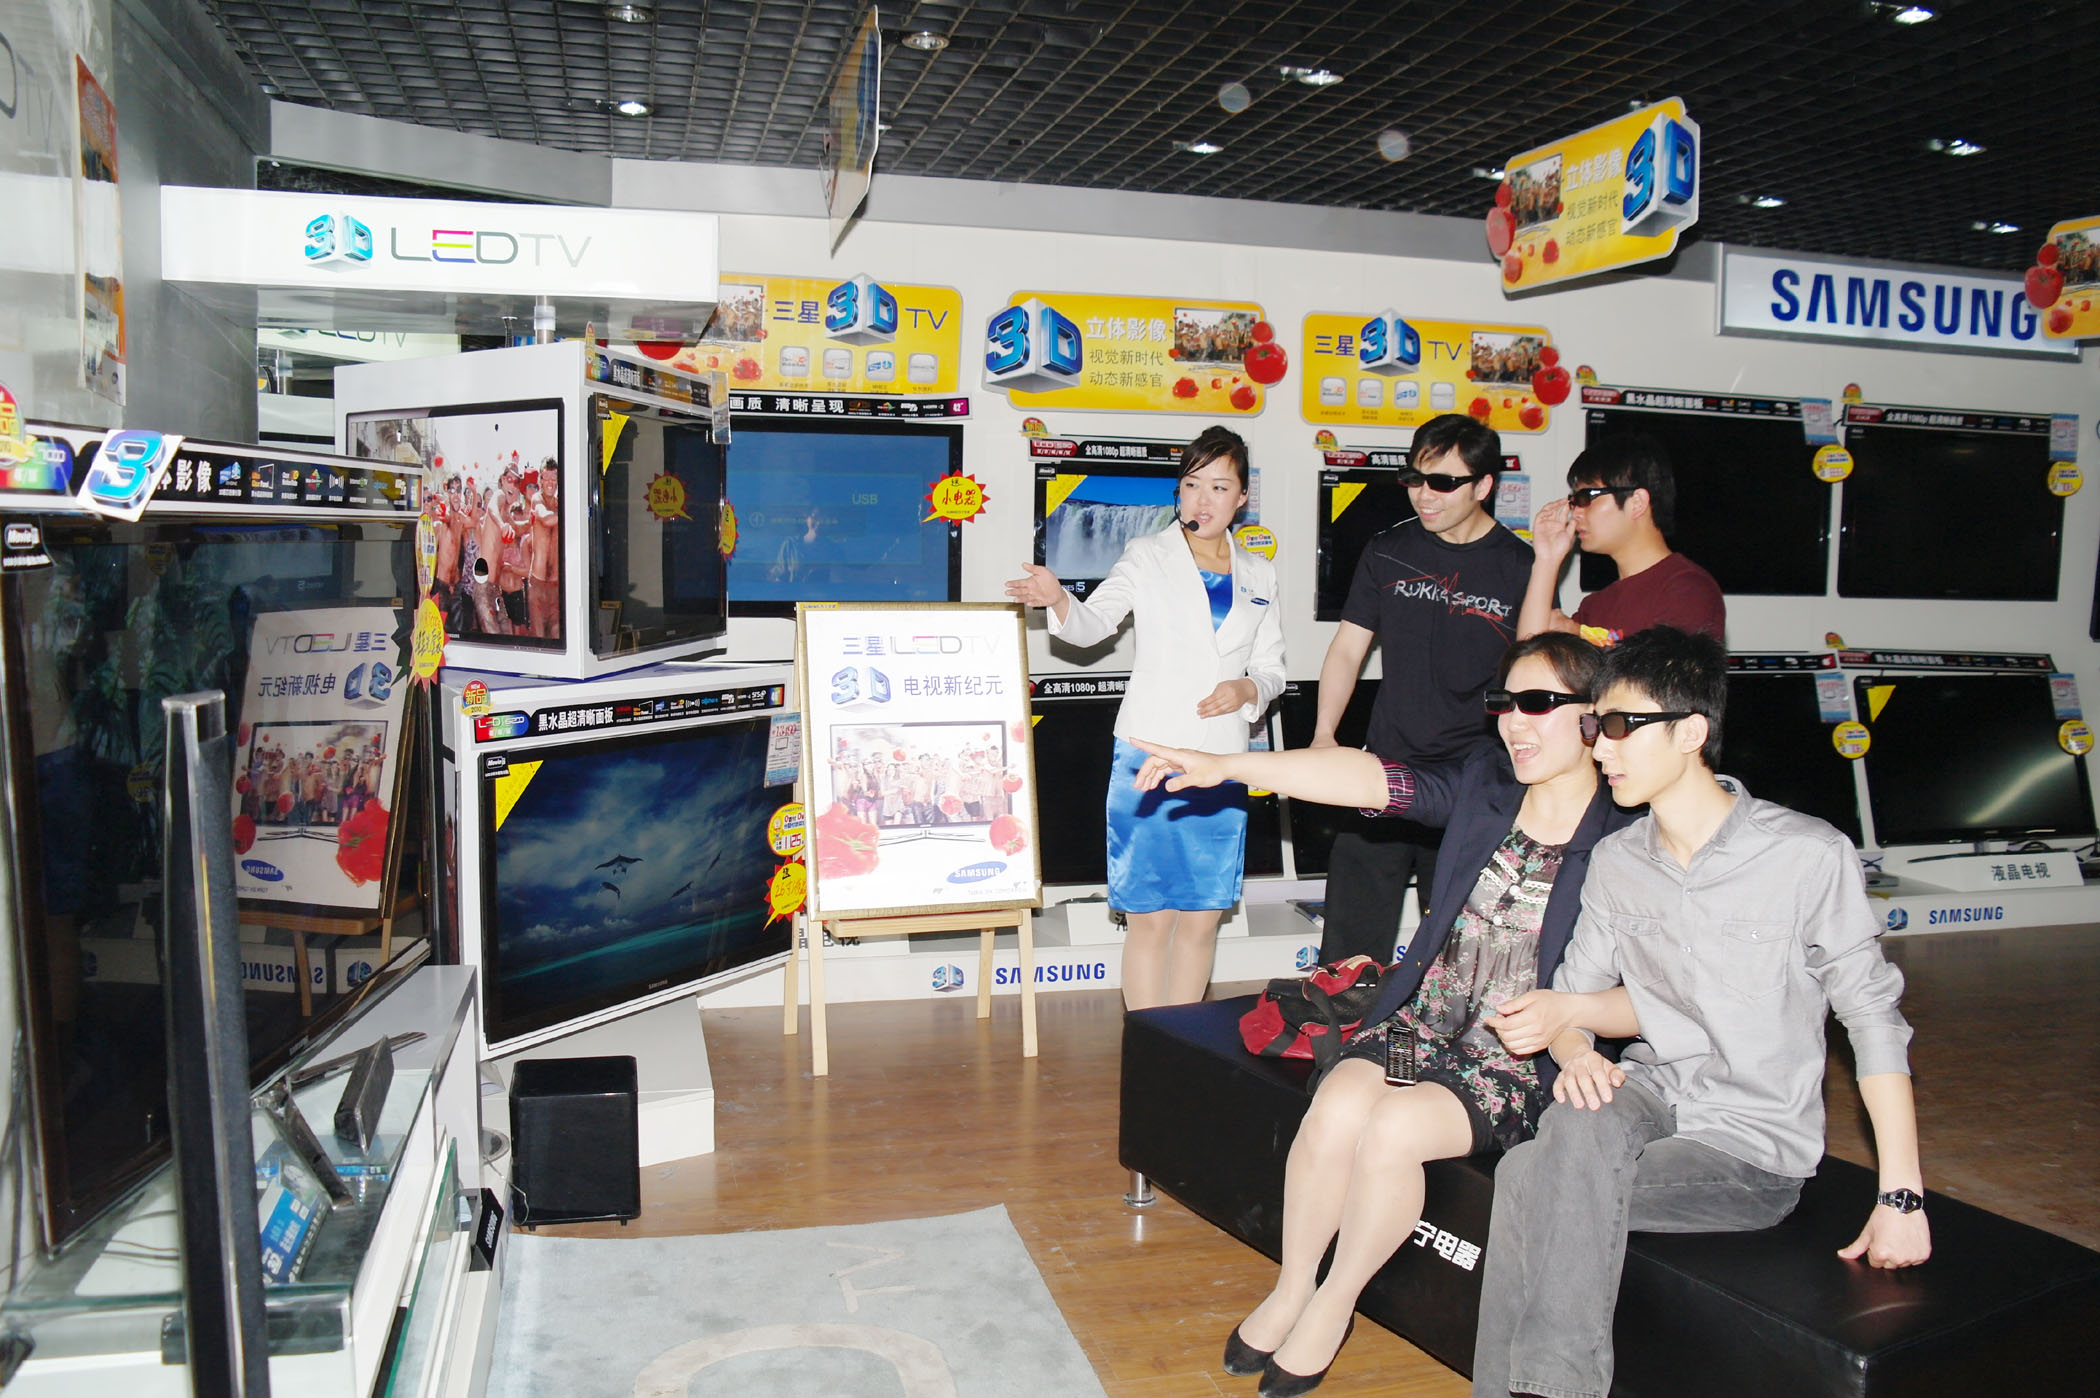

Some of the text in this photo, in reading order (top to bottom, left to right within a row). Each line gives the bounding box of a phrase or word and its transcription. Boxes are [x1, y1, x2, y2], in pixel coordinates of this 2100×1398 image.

[1564, 147, 1623, 192] 立体影像
[1623, 119, 1695, 221] 3D
[305, 214, 373, 262] 3D
[772, 280, 949, 334] 三星 3D TV
[1771, 269, 2038, 341] SAMSUNG
[986, 305, 1083, 376] 3D
[1085, 316, 1168, 343] 立体影像
[1314, 317, 1463, 366] 三星 3D TV
[1088, 349, 1164, 367] 视觉新时代
[1088, 371, 1163, 388] 动态新感官
[728, 396, 763, 411] 画质
[775, 397, 845, 414] 清晰呈现
[852, 493, 879, 506] USB
[942, 487, 977, 506] 小电器
[843, 635, 887, 657] 三星
[465, 688, 488, 705] 新品
[831, 666, 1004, 705] 3D 电视新纪元
[1044, 682, 1097, 695] 全高清1080p
[538, 706, 614, 732] 黑水晶超清晰面板
[954, 867, 1001, 878] SAMSUNG
[1990, 861, 2051, 882] 液晶电视
[1928, 905, 2004, 925] SAMSUNG
[995, 963, 1106, 985] SAMSUNG
[1412, 1219, 1482, 1272] 宁电器
